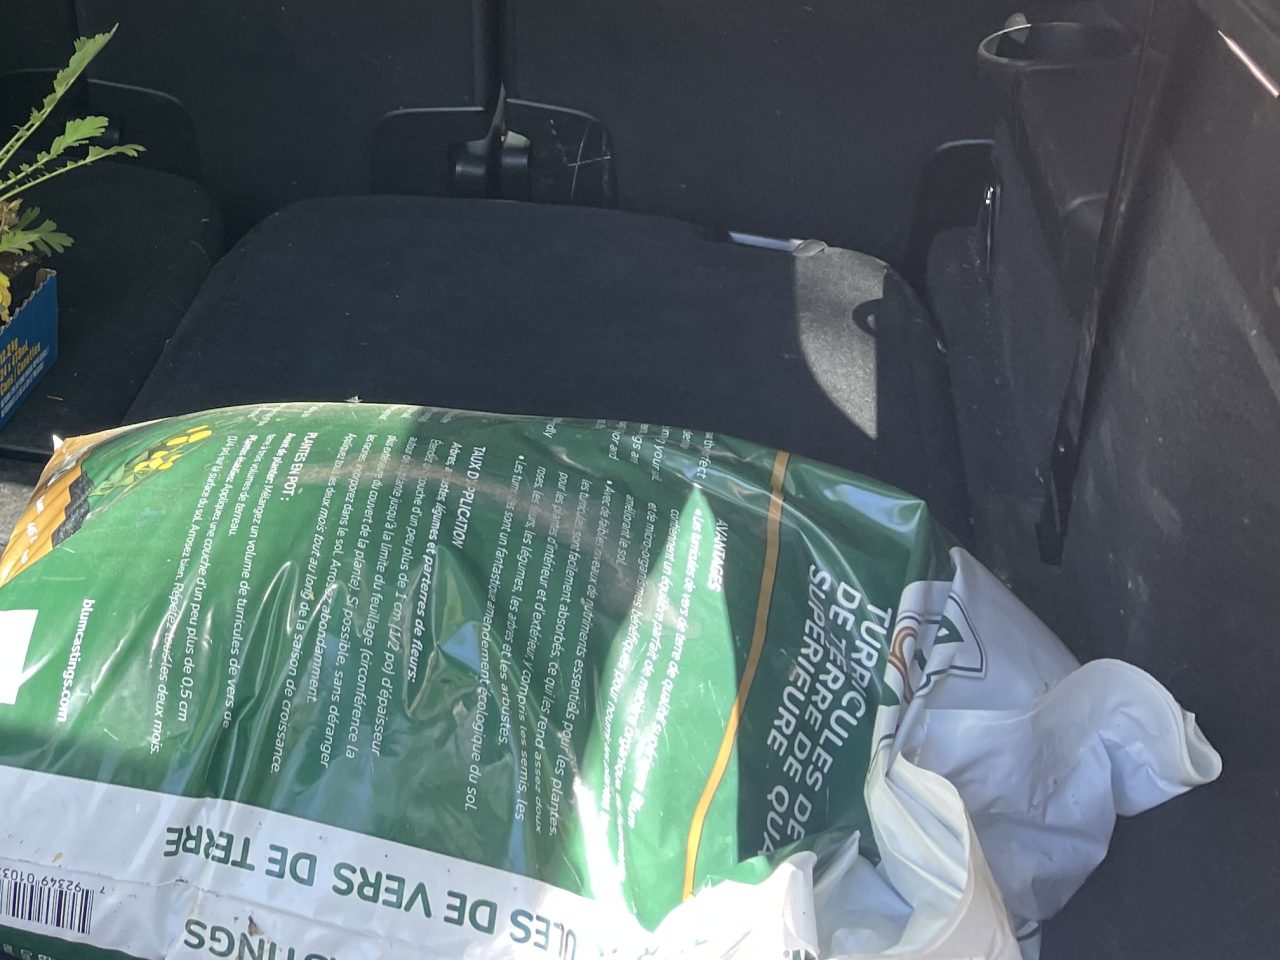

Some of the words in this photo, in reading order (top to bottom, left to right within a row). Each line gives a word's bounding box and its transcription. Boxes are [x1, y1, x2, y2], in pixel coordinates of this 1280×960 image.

[294, 431, 318, 463] PLANTES
[334, 432, 357, 459] Appliquez
[365, 434, 378, 443] les
[382, 434, 398, 447] plus
[261, 456, 285, 484] planter:
[468, 445, 485, 469] TAUX
[513, 460, 526, 474] Les
[200, 472, 220, 498] surface
[241, 462, 262, 491] volumes
[281, 476, 299, 495] POT
[413, 476, 430, 505] couche
[555, 471, 567, 490] pour
[580, 478, 592, 491] les
[209, 482, 235, 521] Appliquez
[238, 491, 250, 502] de
[250, 483, 274, 524] Mélangez
[321, 486, 336, 507] deux
[363, 490, 381, 523] couvert
[555, 491, 567, 503] les
[601, 484, 614, 505] Avec
[227, 503, 247, 537] terreau.
[315, 507, 331, 531] mois
[339, 503, 355, 524] dans
[382, 496, 402, 529] jusqu'à
[408, 506, 423, 526] d'un
[426, 502, 447, 540] légumes
[501, 510, 515, 531] sont
[621, 495, 636, 537] améliorant
[181, 524, 200, 557] Arrosez
[206, 521, 218, 537] une
[249, 524, 259, 538] un
[336, 527, 348, 536] le
[357, 538, 370, 548] la
[360, 524, 373, 536] de
[401, 526, 415, 545] peu
[523, 530, 536, 544] les
[664, 508, 680, 560] contiennent
[198, 537, 216, 576] couche
[242, 539, 259, 579] volume
[311, 534, 325, 556] tout
[376, 543, 391, 572] limite
[397, 546, 414, 570] plus
[426, 541, 439, 554] et
[707, 518, 728, 592] AVANTAGES
[174, 558, 190, 581] bien.
[308, 557, 317, 571] au
[346, 549, 367, 591] plante).
[484, 546, 507, 602] fantastique
[561, 551, 580, 603] facilement
[193, 577, 208, 601] d'un
[239, 580, 251, 596] de
[299, 573, 317, 599] long
[323, 558, 341, 602] Arrosez
[372, 574, 386, 590] du
[397, 572, 409, 588] de
[414, 555, 436, 616] parterres
[164, 581, 184, 629] Répétez
[187, 602, 200, 625] peu
[298, 601, 311, 616] de
[346, 595, 358, 607] Si
[391, 601, 401, 621] cm
[509, 596, 522, 611] les
[679, 593, 689, 614] vers
[829, 581, 861, 631] DE
[230, 597, 248, 655] turricules
[295, 619, 307, 630] la
[361, 592, 382, 645] feuillage
[413, 618, 426, 636] de
[503, 613, 519, 642] arbres
[575, 598, 596, 657] nutriments
[184, 627, 199, 655] plus
[385, 624, 401, 650] (1/2
[480, 600, 497, 684] amendement
[616, 608, 642, 670] bénéfiques
[645, 619, 664, 657] parfait
[671, 632, 687, 660] terre
[54, 597, 95, 723] blumcastings.com
[184, 656, 196, 675] de
[228, 658, 240, 676] de
[288, 633, 305, 675] saison
[305, 605, 332, 704] abondamment.
[381, 651, 397, 674] po)
[407, 638, 423, 683] fleurs:
[159, 661, 171, 682] les
[500, 659, 511, 679] les
[805, 633, 846, 730] TERRE
[179, 676, 194, 699] 0,5
[225, 678, 235, 707] vers
[284, 679, 297, 696] de
[331, 670, 342, 701] sans
[346, 648, 372, 742] (circonférence
[515, 668, 533, 721] compris
[565, 658, 585, 719] essentiels
[606, 669, 625, 701] pour
[806, 604, 891, 791] TURRICULES
[155, 684, 168, 717] deux
[177, 700, 187, 721] cm
[541, 696, 554, 713] les
[368, 677, 393, 757] d'épaisseur
[468, 687, 490, 761] écologique
[498, 683, 511, 747] arbustes.
[149, 719, 164, 755] mois.
[270, 699, 293, 774] croissance.
[317, 704, 341, 768] déranger
[519, 725, 530, 746] les
[535, 715, 550, 748] rend
[556, 720, 571, 752] pour
[346, 745, 358, 758] la
[555, 754, 568, 775] les
[783, 731, 810, 783] DE
[534, 751, 542, 792] assez
[463, 786, 477, 811] sol.
[516, 799, 527, 820] les
[533, 796, 544, 834] doux
[164, 825, 255, 871] TERRE
[267, 845, 315, 887] DE
[40, 875, 82, 893] 92349
[99, 885, 106, 895] 7
[333, 862, 433, 919] VERS
[446, 889, 498, 935] DE
